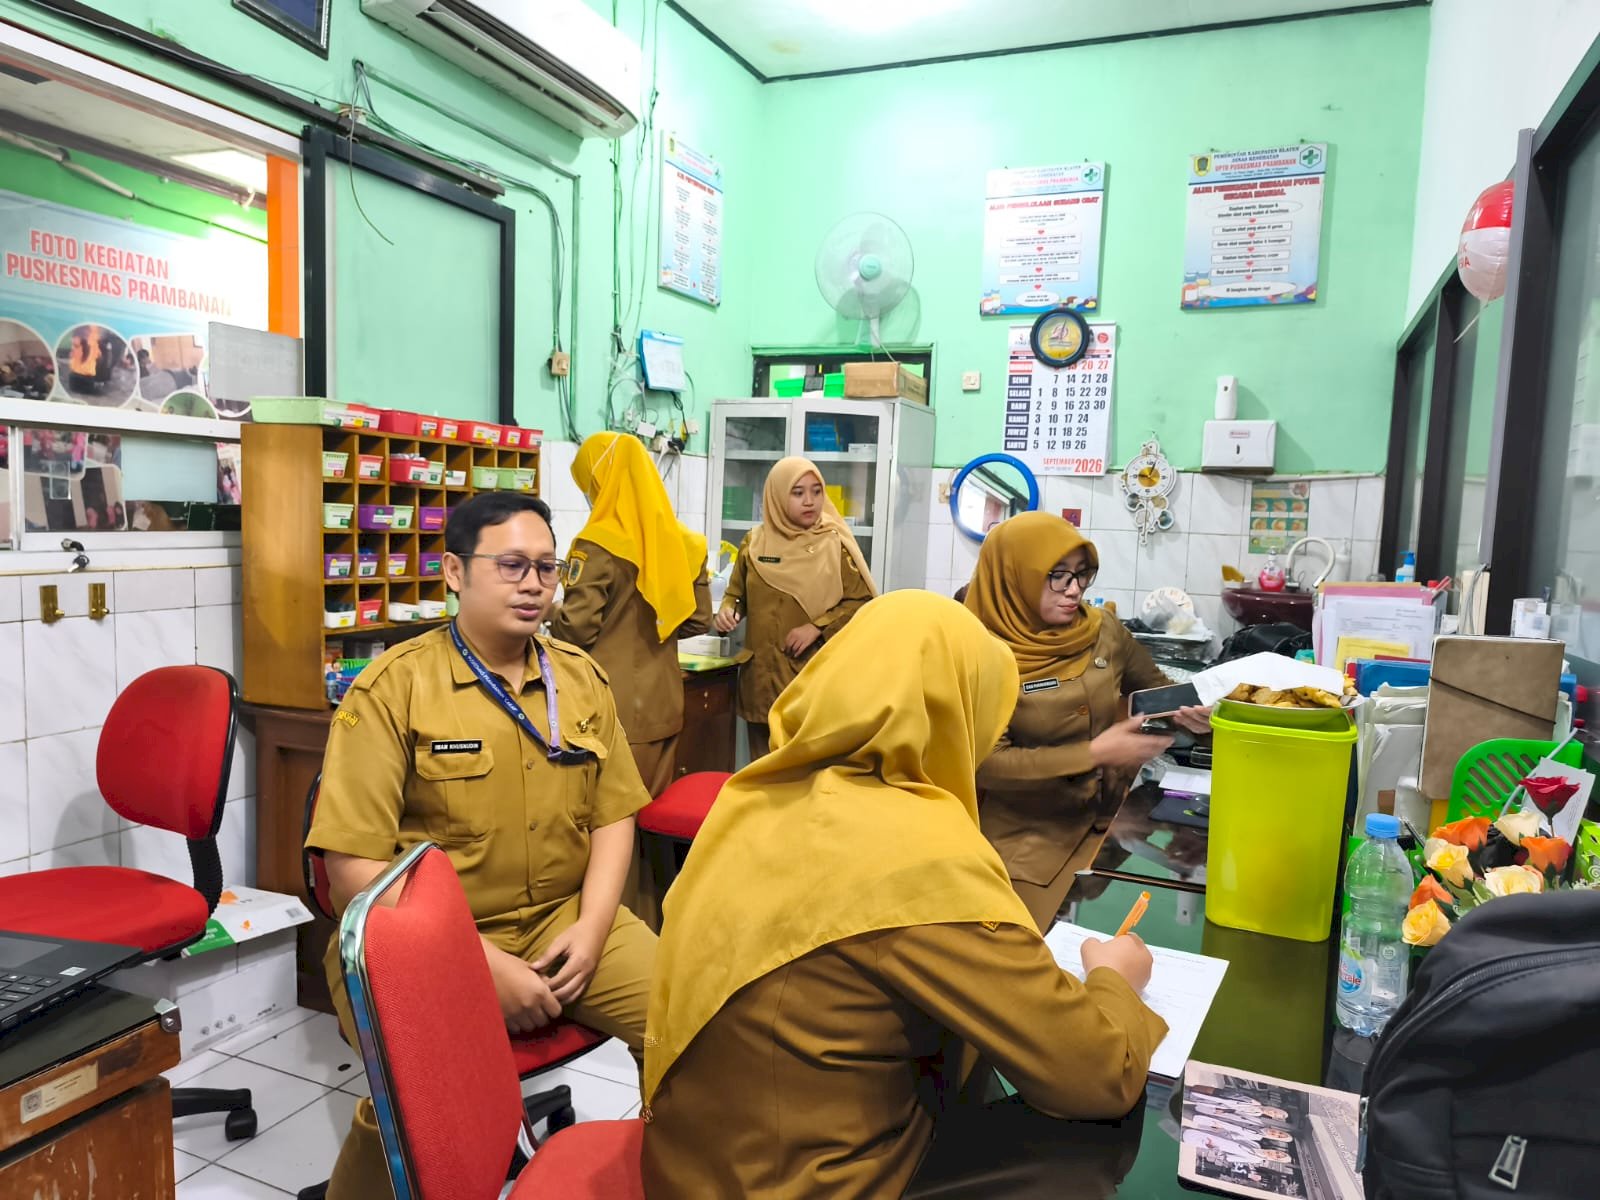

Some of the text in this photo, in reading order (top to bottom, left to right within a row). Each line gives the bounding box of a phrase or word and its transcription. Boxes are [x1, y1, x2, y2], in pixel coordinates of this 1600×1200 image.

[30, 229, 169, 280] FOTO KEGIATAN
[7, 253, 233, 318] PUSKESMAS PRAMBANAN
[1081, 360, 1094, 370] 20
[1098, 360, 1109, 370] 27
[1054, 375, 1059, 384] 7
[1067, 374, 1076, 384] 14
[1081, 374, 1092, 384] 21
[1096, 373, 1108, 384] 28
[1038, 388, 1042, 397] 1
[1052, 388, 1058, 398] 8
[1066, 387, 1076, 397] 15
[1080, 387, 1092, 397] 22
[1095, 387, 1107, 397] 29
[1036, 401, 1042, 411] 2
[1051, 401, 1057, 411] 9
[1065, 401, 1075, 411] 16
[1079, 400, 1090, 411] 23
[1094, 400, 1106, 410] 30
[1035, 414, 1041, 424] 3
[1049, 414, 1059, 424] 10
[1065, 414, 1073, 424] 17
[1078, 414, 1089, 424] 24
[1034, 427, 1040, 437] 4
[1049, 427, 1057, 437] 11
[1062, 427, 1072, 437] 18
[1076, 427, 1088, 437] 25
[1033, 440, 1039, 450] 5
[1047, 440, 1057, 450] 12
[1062, 440, 1072, 450] 19
[1075, 440, 1087, 450] 26
[1043, 458, 1075, 466] SEPTEMBER
[1074, 458, 1103, 473] 2026
